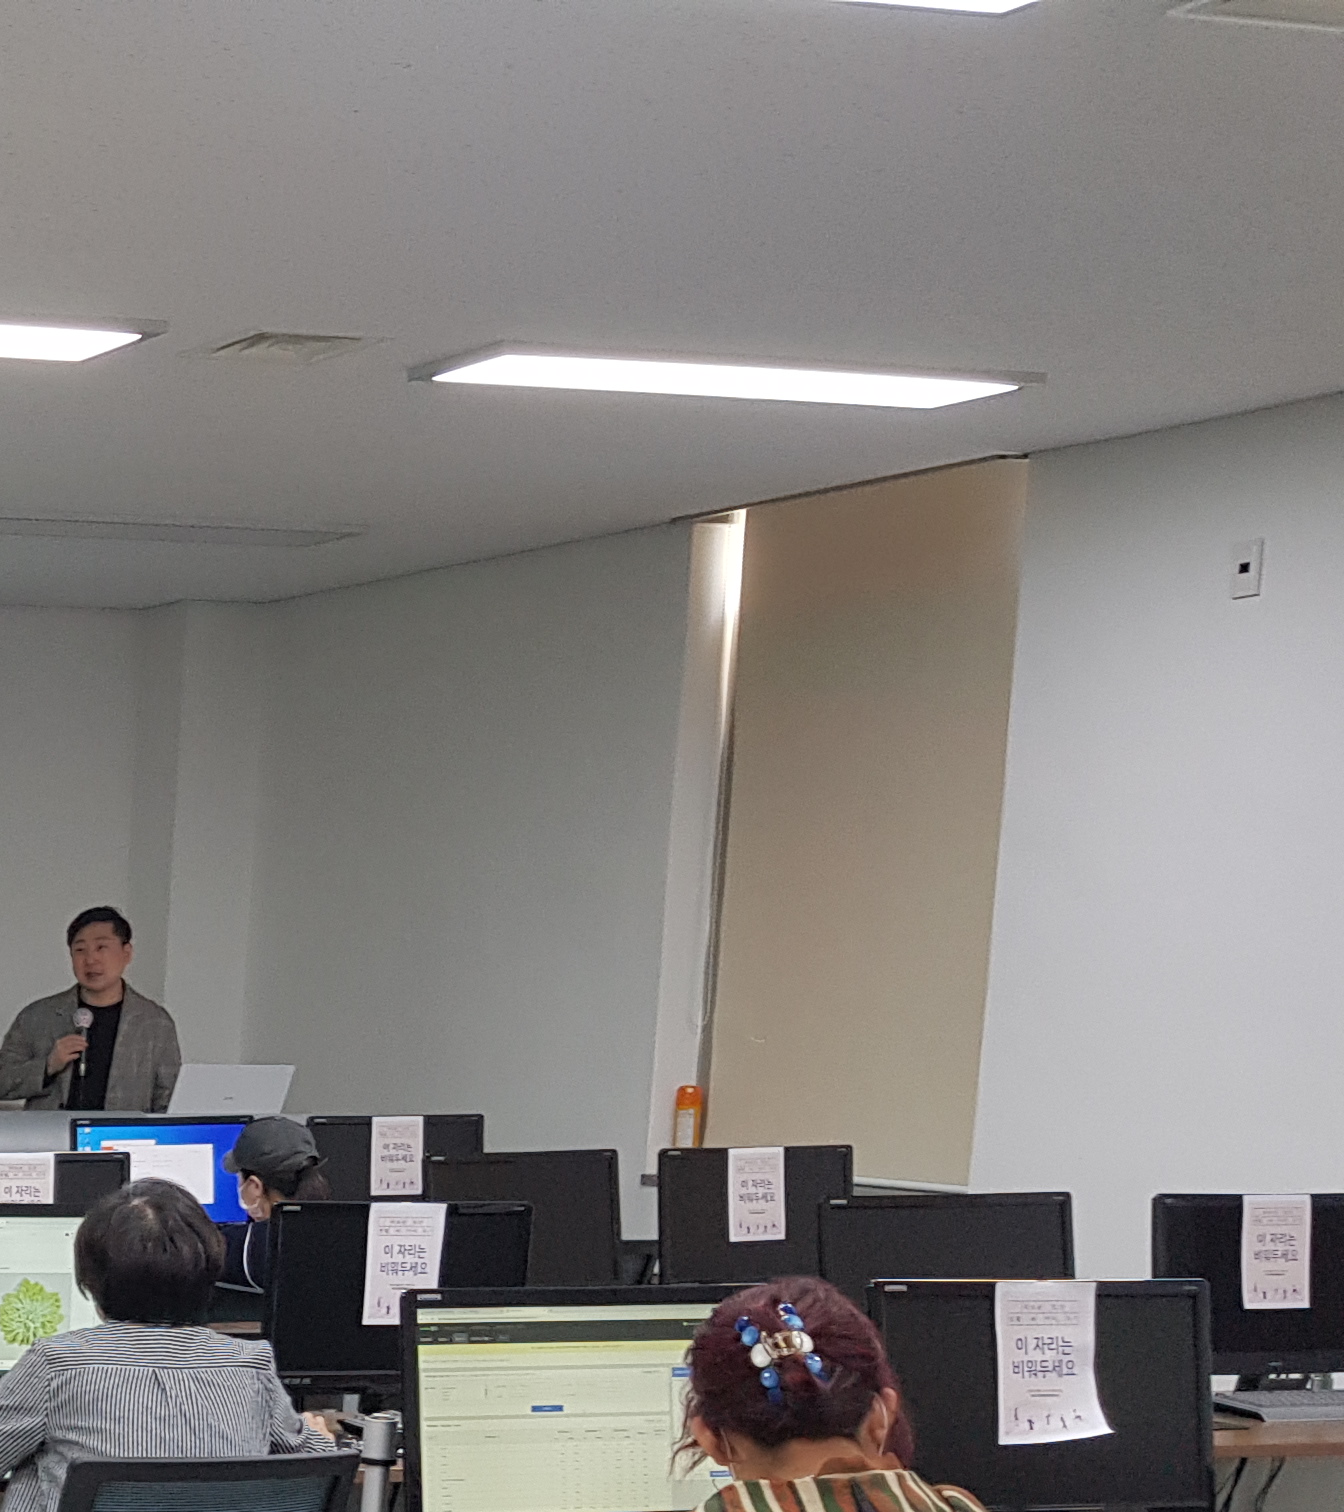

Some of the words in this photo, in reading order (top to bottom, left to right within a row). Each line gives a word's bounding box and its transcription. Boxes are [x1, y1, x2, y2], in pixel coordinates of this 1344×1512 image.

[4, 1185, 12, 1198] 이
[15, 1185, 42, 1198] 자리는
[384, 1244, 394, 1259] 이
[397, 1243, 427, 1259] 자리는
[380, 1262, 429, 1277] 비워두세요
[1015, 1336, 1028, 1356] 이
[1033, 1335, 1074, 1356] 자리는
[1012, 1359, 1077, 1379] 비워두세요
